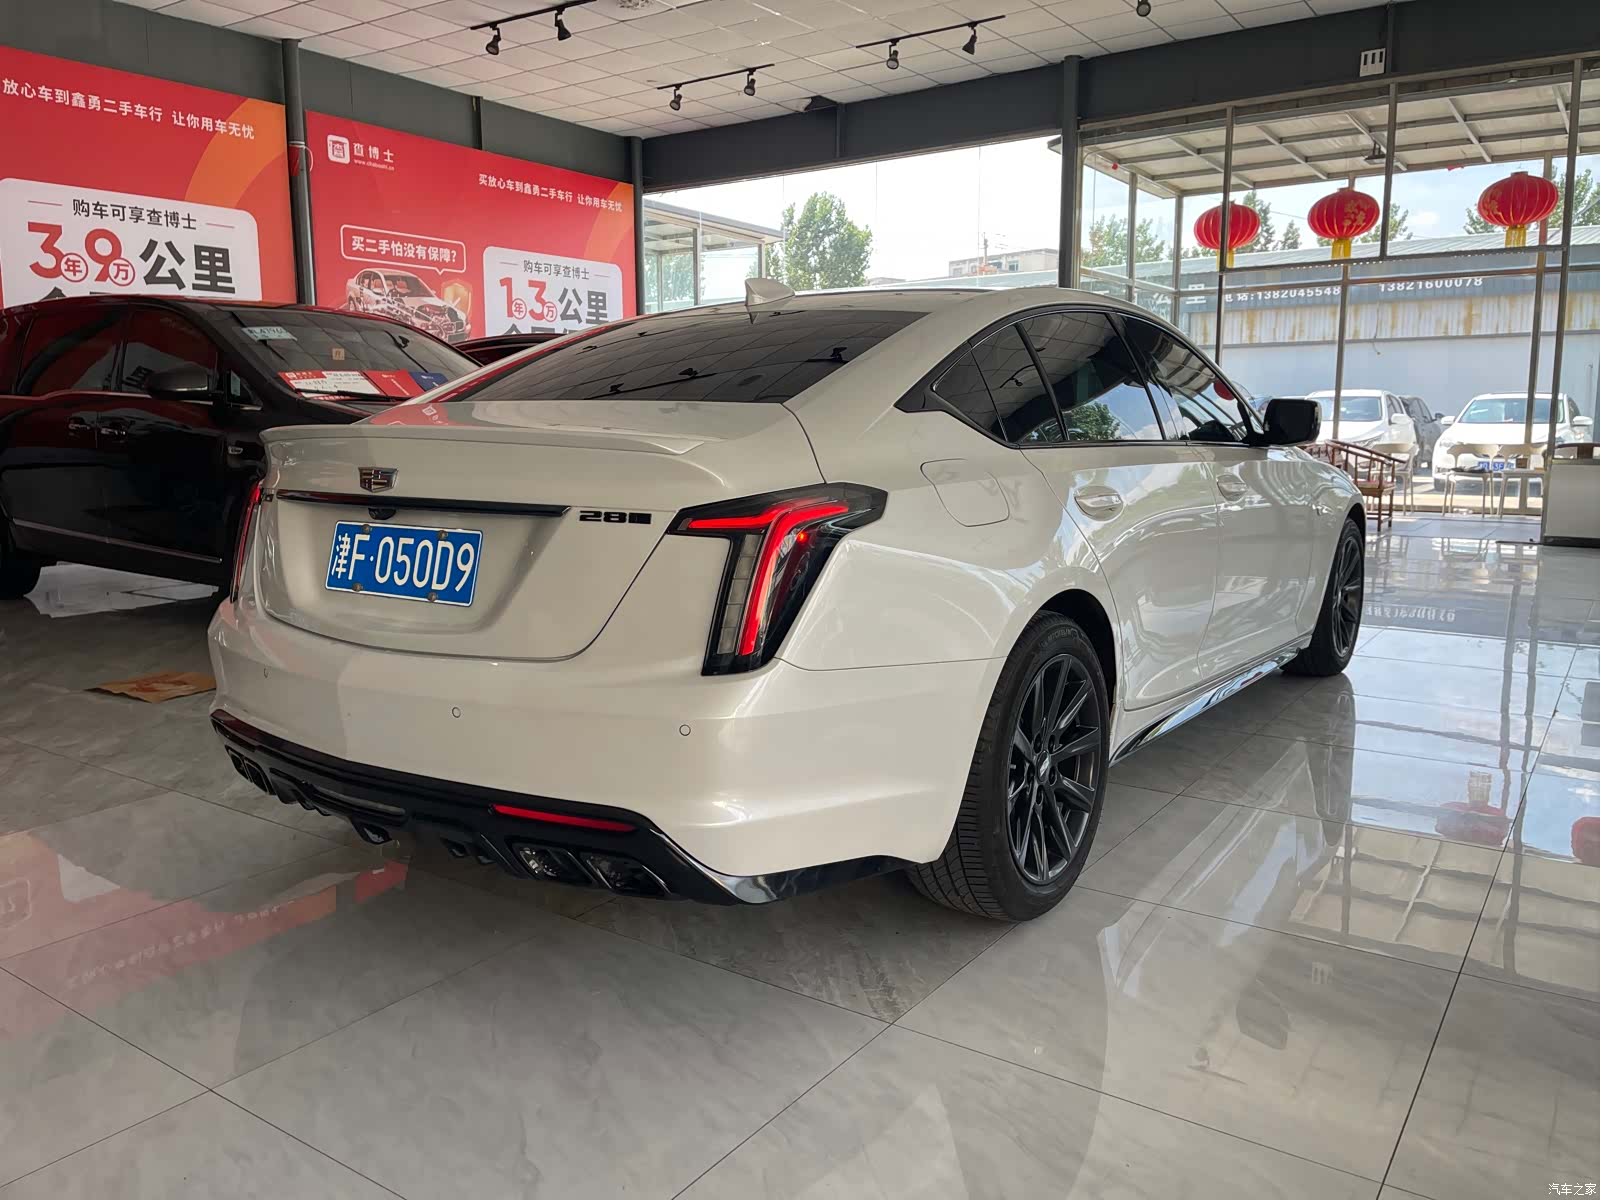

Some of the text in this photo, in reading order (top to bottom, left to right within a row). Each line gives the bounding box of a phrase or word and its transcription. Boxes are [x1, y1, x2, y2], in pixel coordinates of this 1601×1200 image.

[2, 78, 255, 139] 放心车到鑫勇二手车行 让你用车无忧
[479, 173, 622, 212] 买放心车到鑫勇二手车行 让你用车无忧
[72, 199, 197, 230] 购车可享查博士
[351, 235, 457, 263] 买二手怕没有保障?
[523, 259, 590, 280] 购车可享查博士
[331, 532, 476, 593] 津F·050D9
